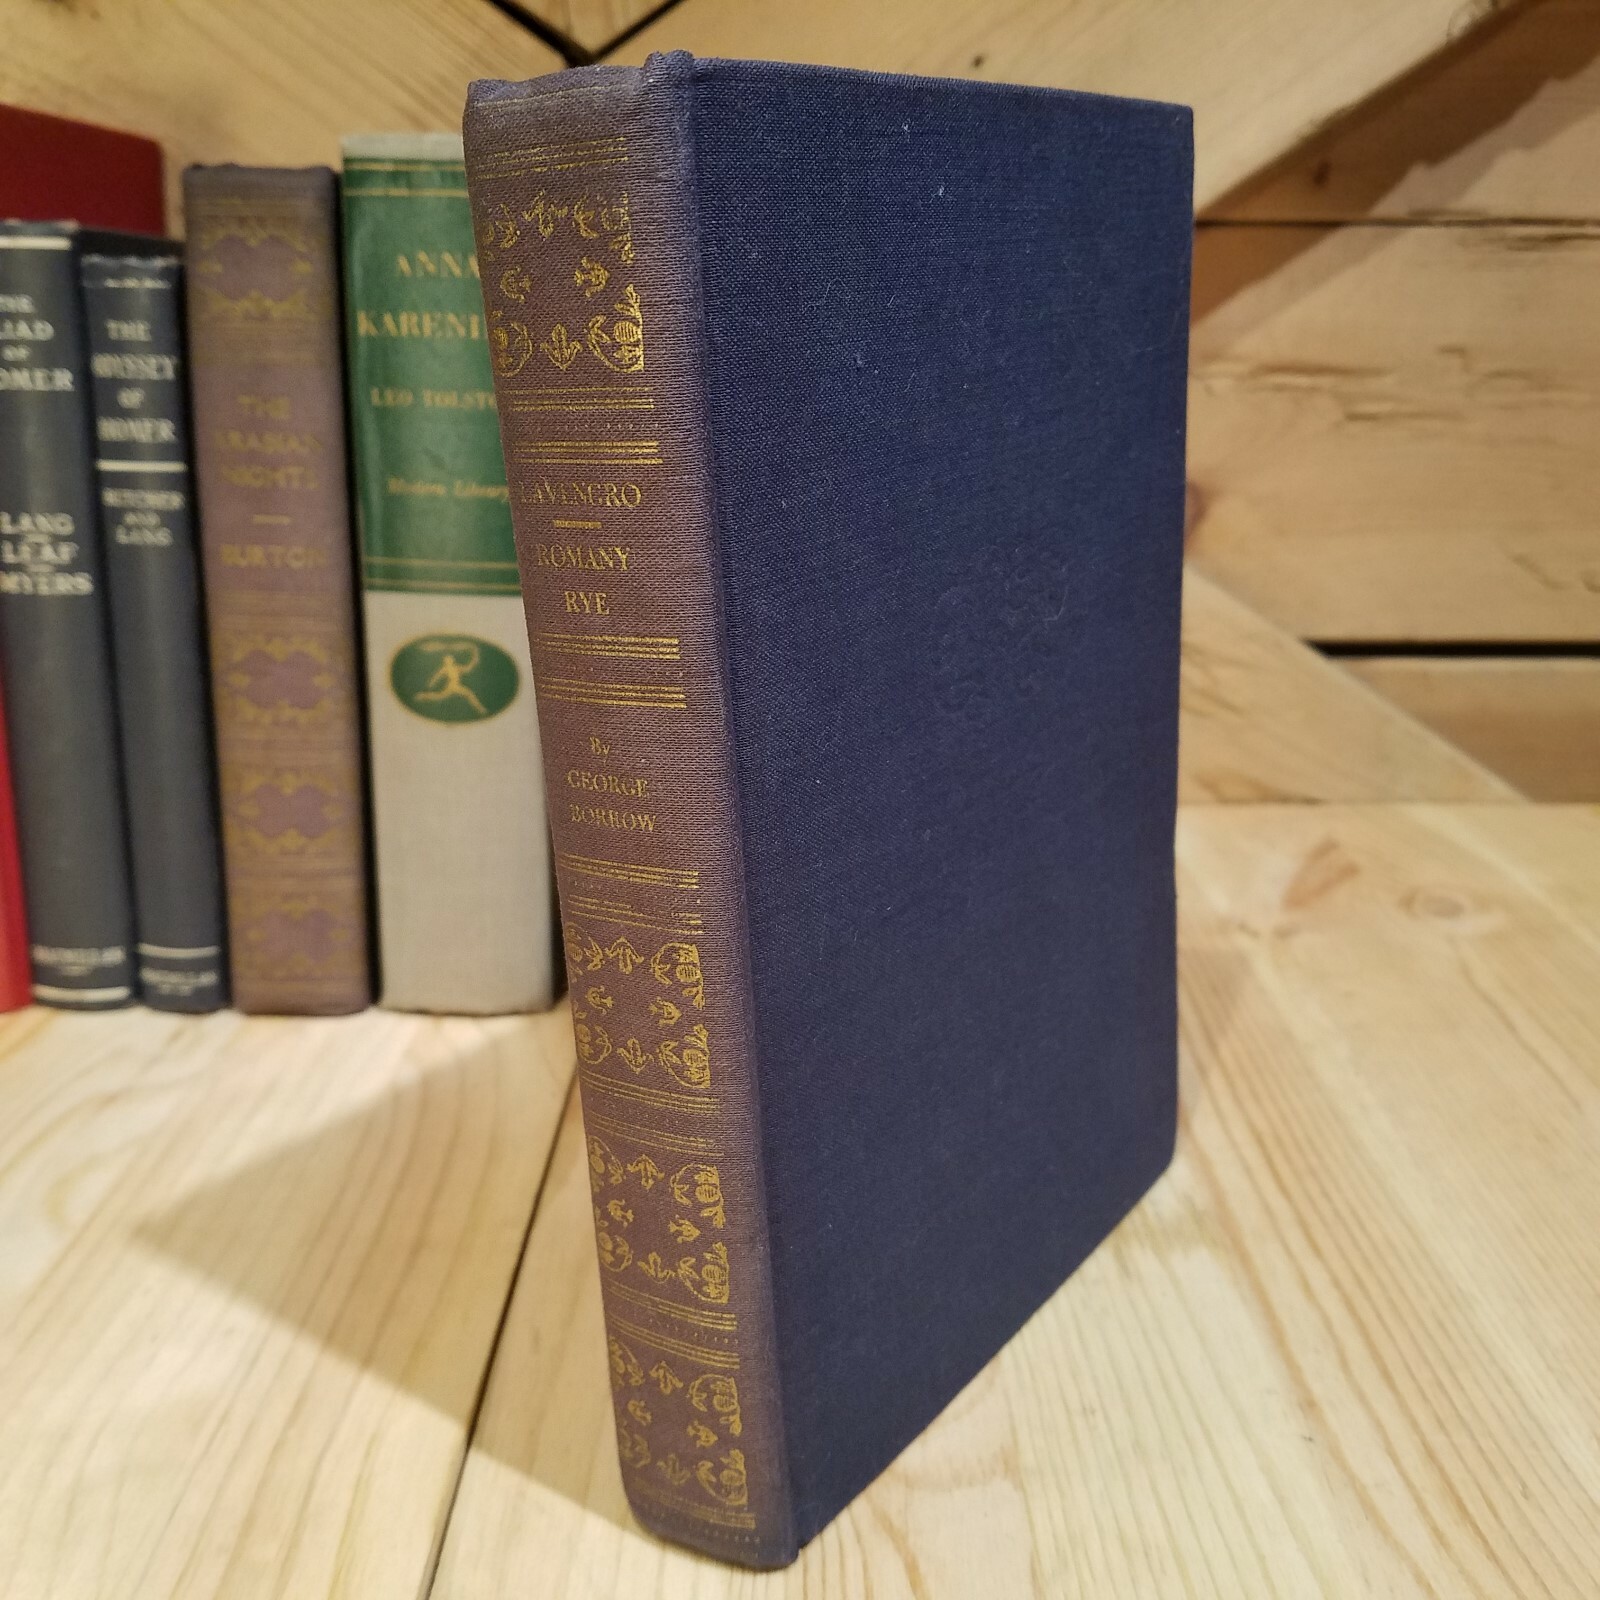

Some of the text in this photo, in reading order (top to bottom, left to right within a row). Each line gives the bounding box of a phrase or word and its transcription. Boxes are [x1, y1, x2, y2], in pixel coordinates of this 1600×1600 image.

[357, 310, 488, 340] KARENI
[422, 388, 498, 411] TOLSTO
[537, 541, 630, 571] ROMANY
[564, 590, 610, 615] RYE
[590, 736, 611, 768] By
[567, 769, 650, 798] GEORGE
[570, 803, 657, 832] BORROW
